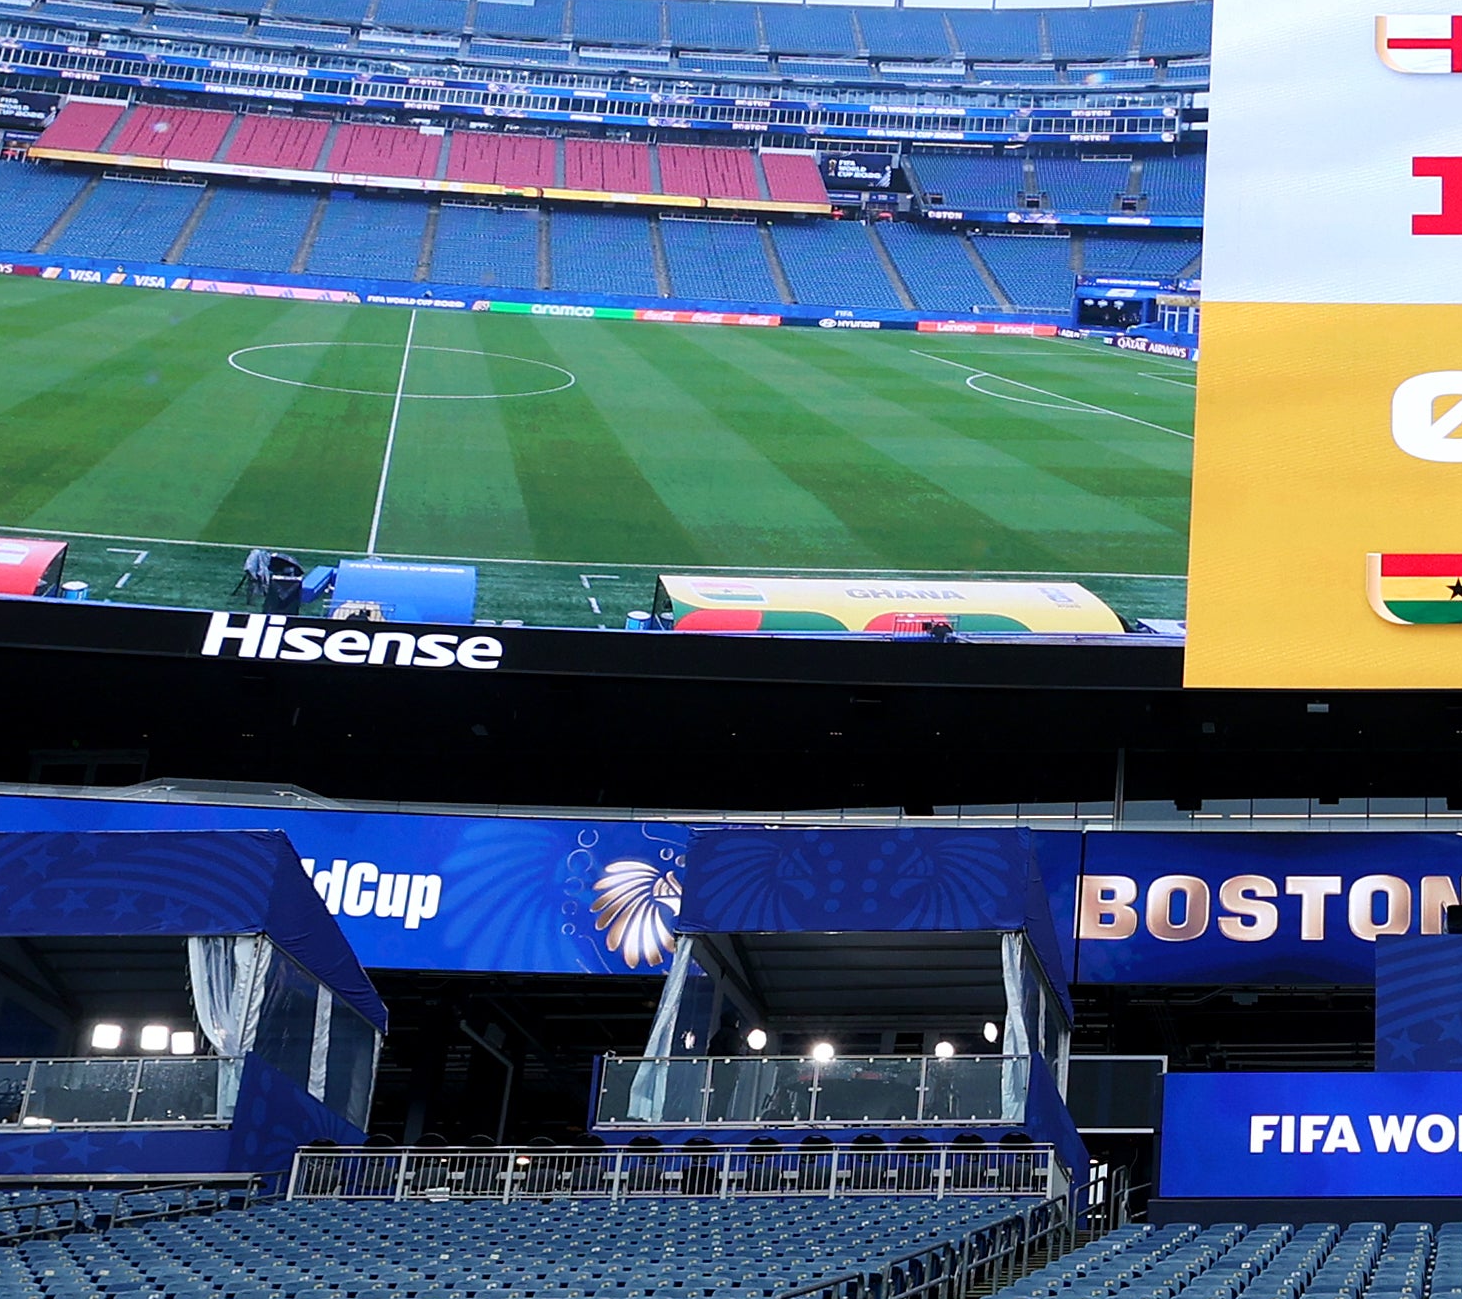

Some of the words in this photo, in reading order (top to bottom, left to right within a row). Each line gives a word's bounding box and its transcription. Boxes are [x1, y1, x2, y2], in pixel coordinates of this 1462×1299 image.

[69, 269, 101, 283] VISA
[133, 275, 165, 289] VISA
[531, 304, 594, 318] aramco
[937, 322, 976, 333] Lenovo
[993, 324, 1033, 335] Lenovo
[1116, 337, 1147, 351] QATAR
[1148, 342, 1187, 359] AIRWAYS
[845, 587, 965, 600] GHANA
[201, 611, 503, 670] Hisense
[1249, 1114, 1361, 1153] FIFA
